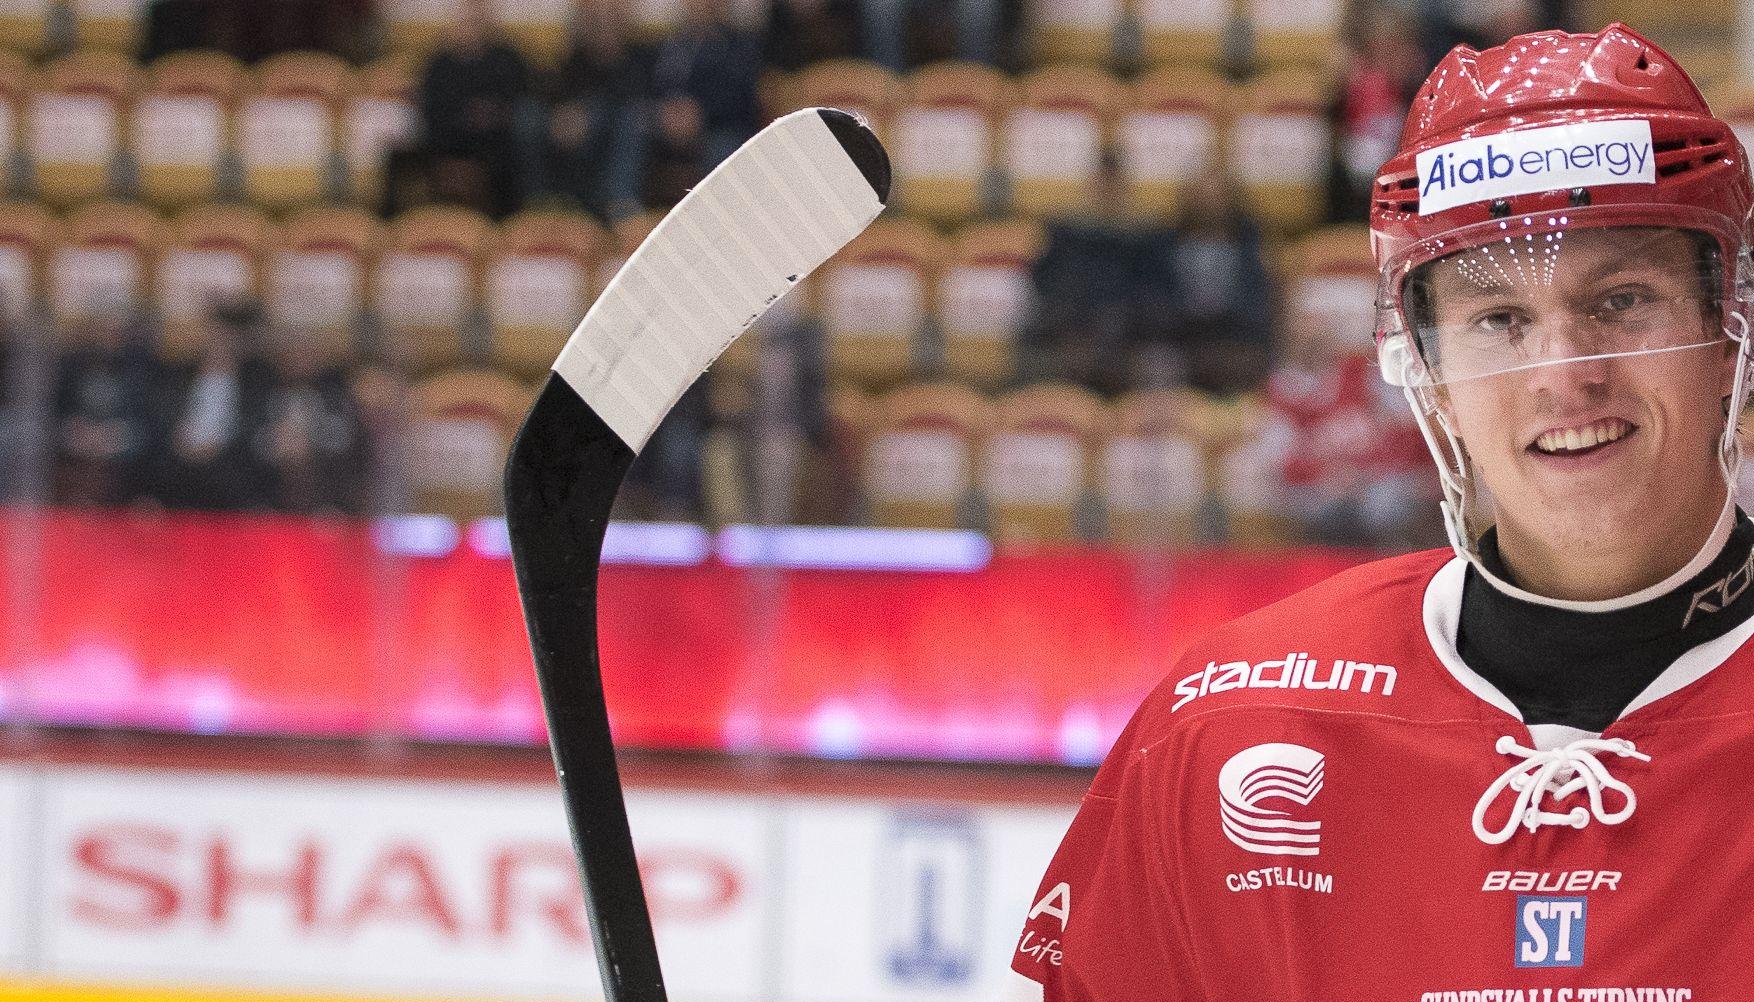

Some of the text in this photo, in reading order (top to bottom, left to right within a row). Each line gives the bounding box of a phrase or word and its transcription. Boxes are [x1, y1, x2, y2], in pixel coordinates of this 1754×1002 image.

[1172, 652, 1398, 714] stadium
[68, 820, 746, 946] SHARP
[1482, 870, 1623, 892] BAUER
[1511, 900, 1582, 964] ST
